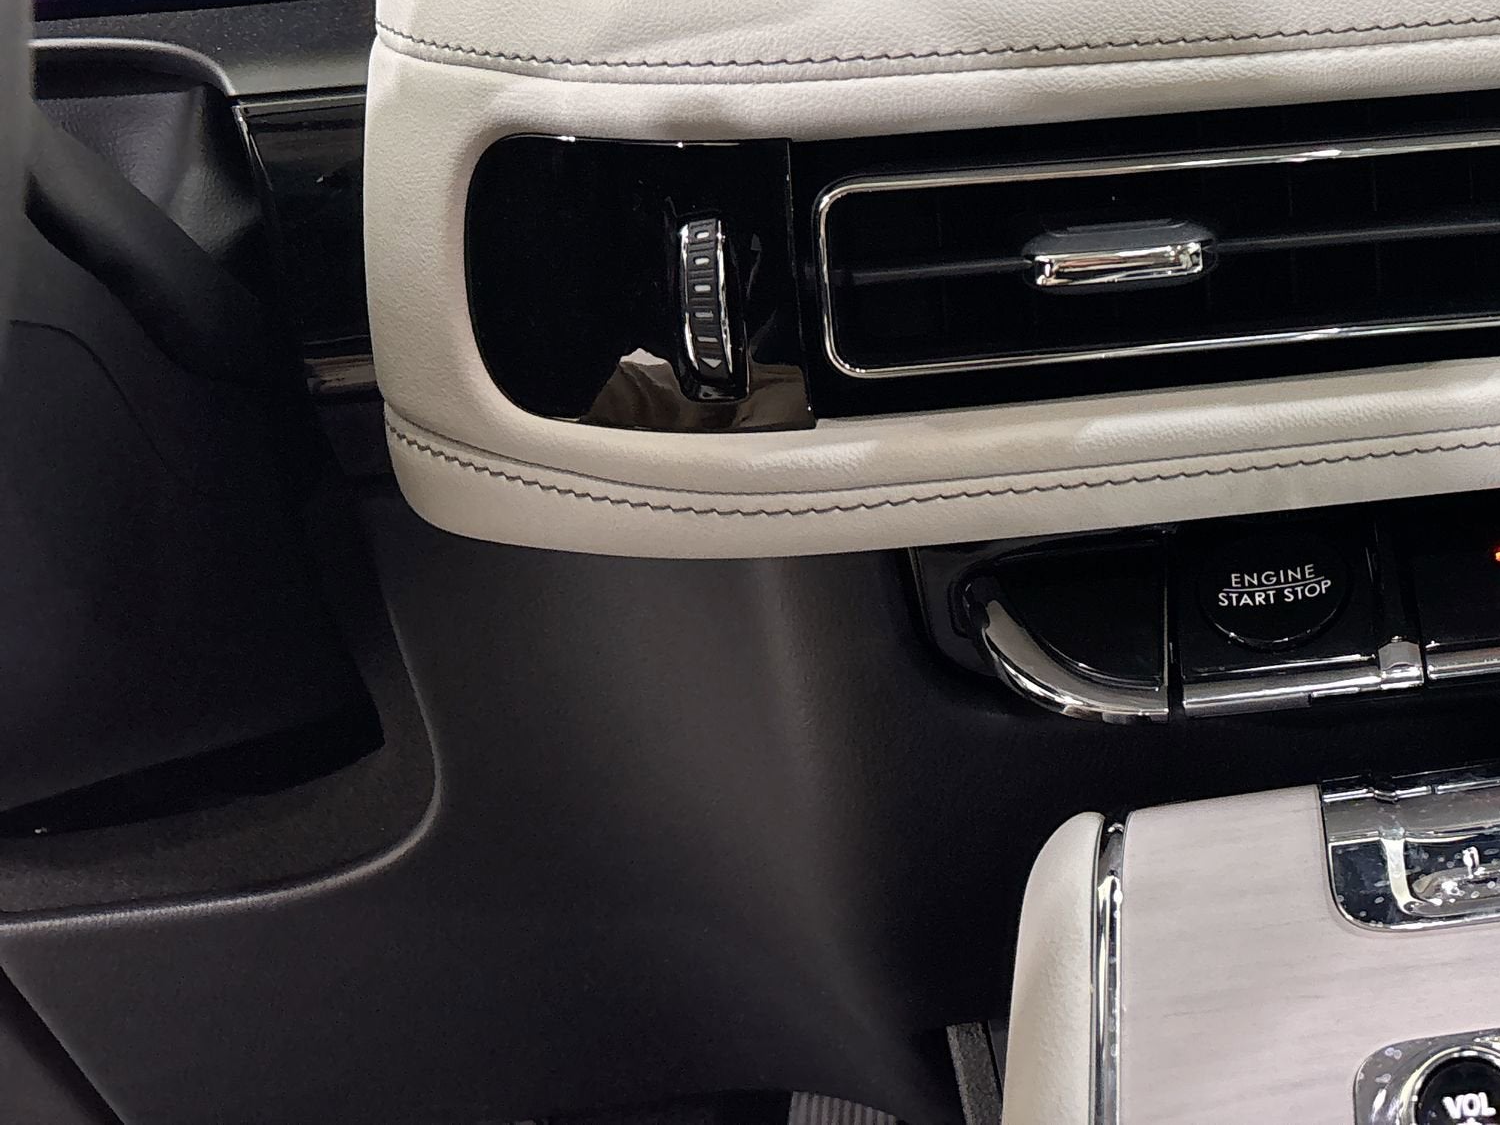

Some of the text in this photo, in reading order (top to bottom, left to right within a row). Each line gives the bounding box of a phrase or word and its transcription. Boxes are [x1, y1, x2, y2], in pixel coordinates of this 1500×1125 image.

[1230, 563, 1316, 588] ENGINE
[1218, 579, 1332, 607] START STOP
[1442, 1091, 1497, 1120] VOL
